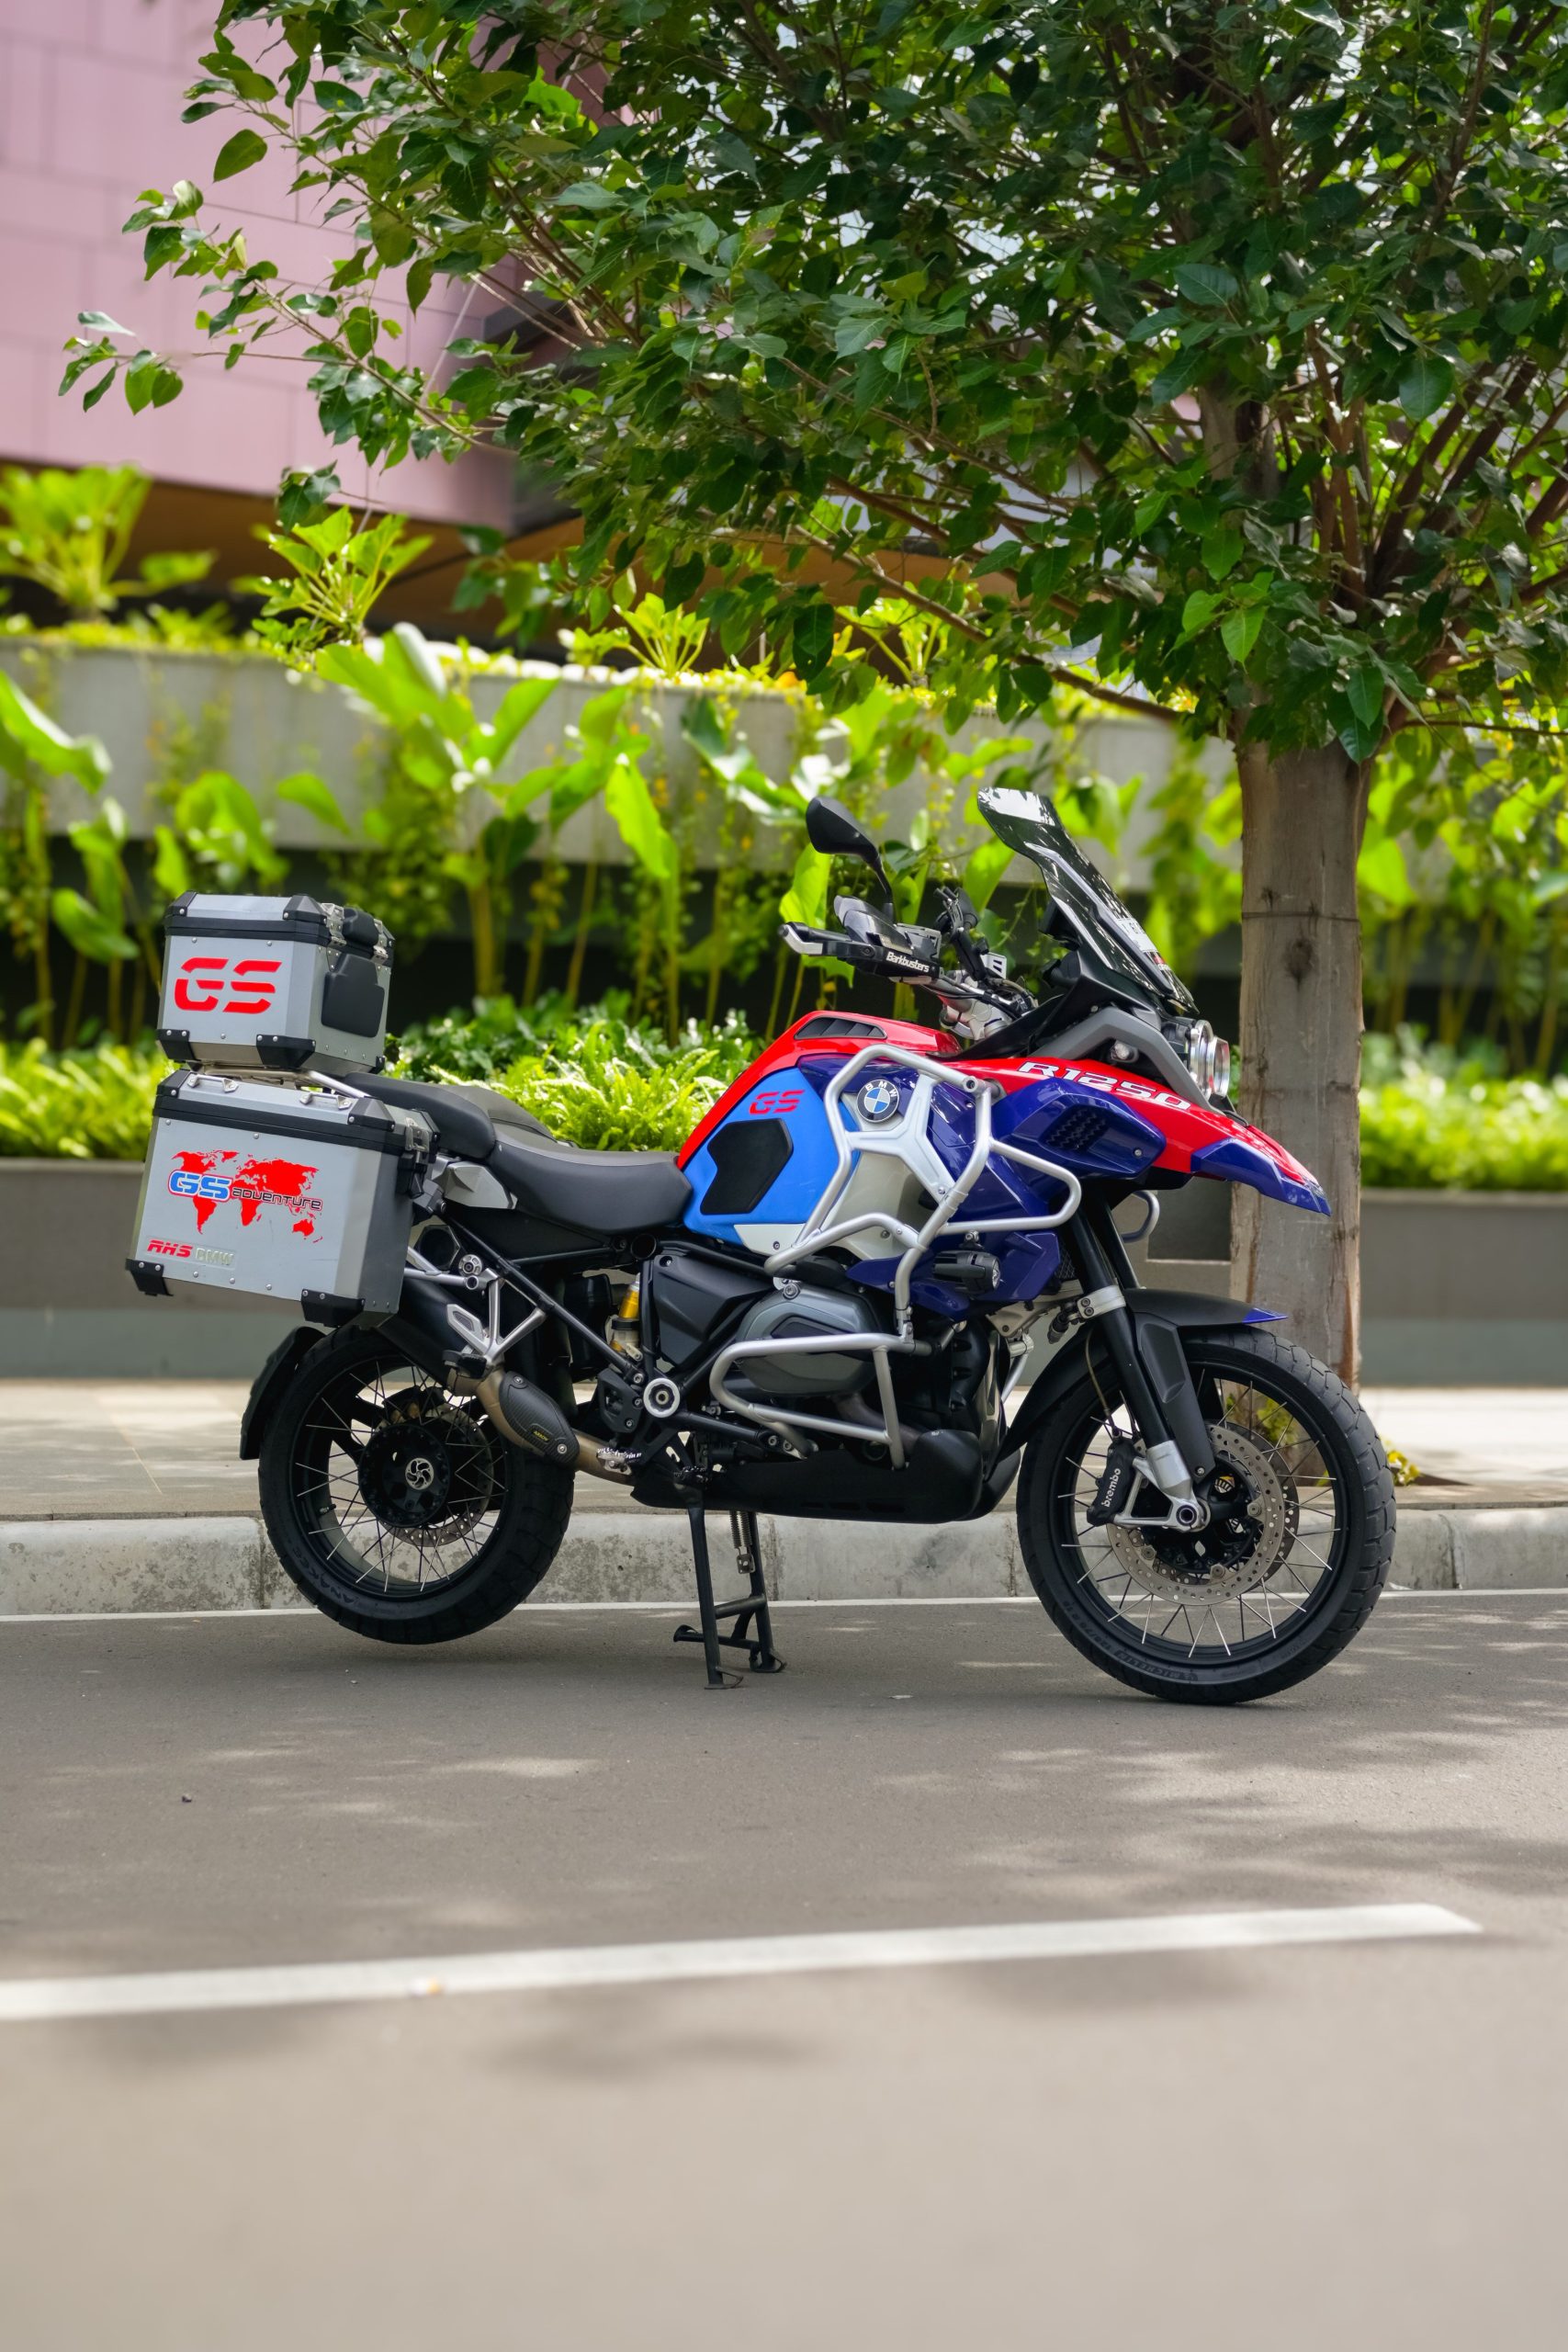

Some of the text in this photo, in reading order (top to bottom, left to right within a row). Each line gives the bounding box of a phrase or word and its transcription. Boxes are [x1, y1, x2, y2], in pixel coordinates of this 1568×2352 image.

[886, 951, 930, 973] Barkbusters
[175, 956, 283, 1014] GS
[864, 1080, 897, 1098] BMW
[1017, 1060, 1191, 1111] R1250
[749, 1089, 806, 1115] GS
[169, 1170, 231, 1201] GS
[1100, 1468, 1122, 1508] brembo
